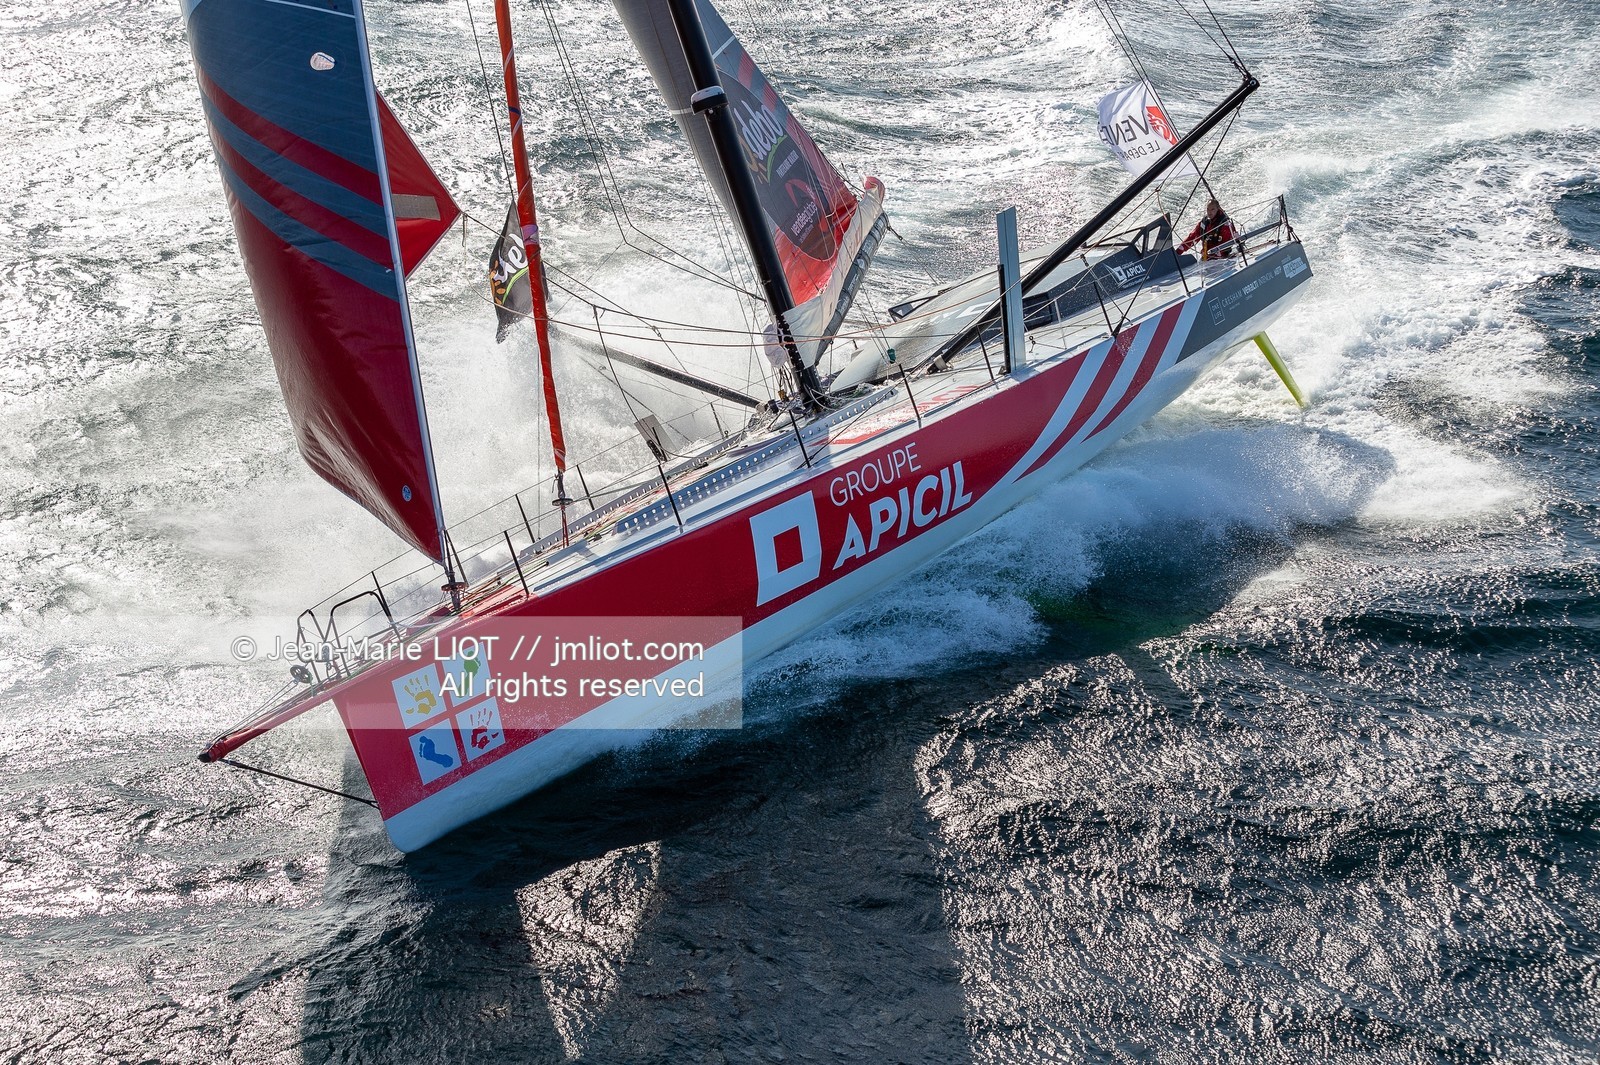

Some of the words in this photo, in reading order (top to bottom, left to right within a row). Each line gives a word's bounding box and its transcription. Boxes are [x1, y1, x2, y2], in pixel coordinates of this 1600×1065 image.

[1125, 264, 1146, 279] APICIL
[830, 442, 922, 507] GROUPE
[832, 460, 973, 571] APICIL
